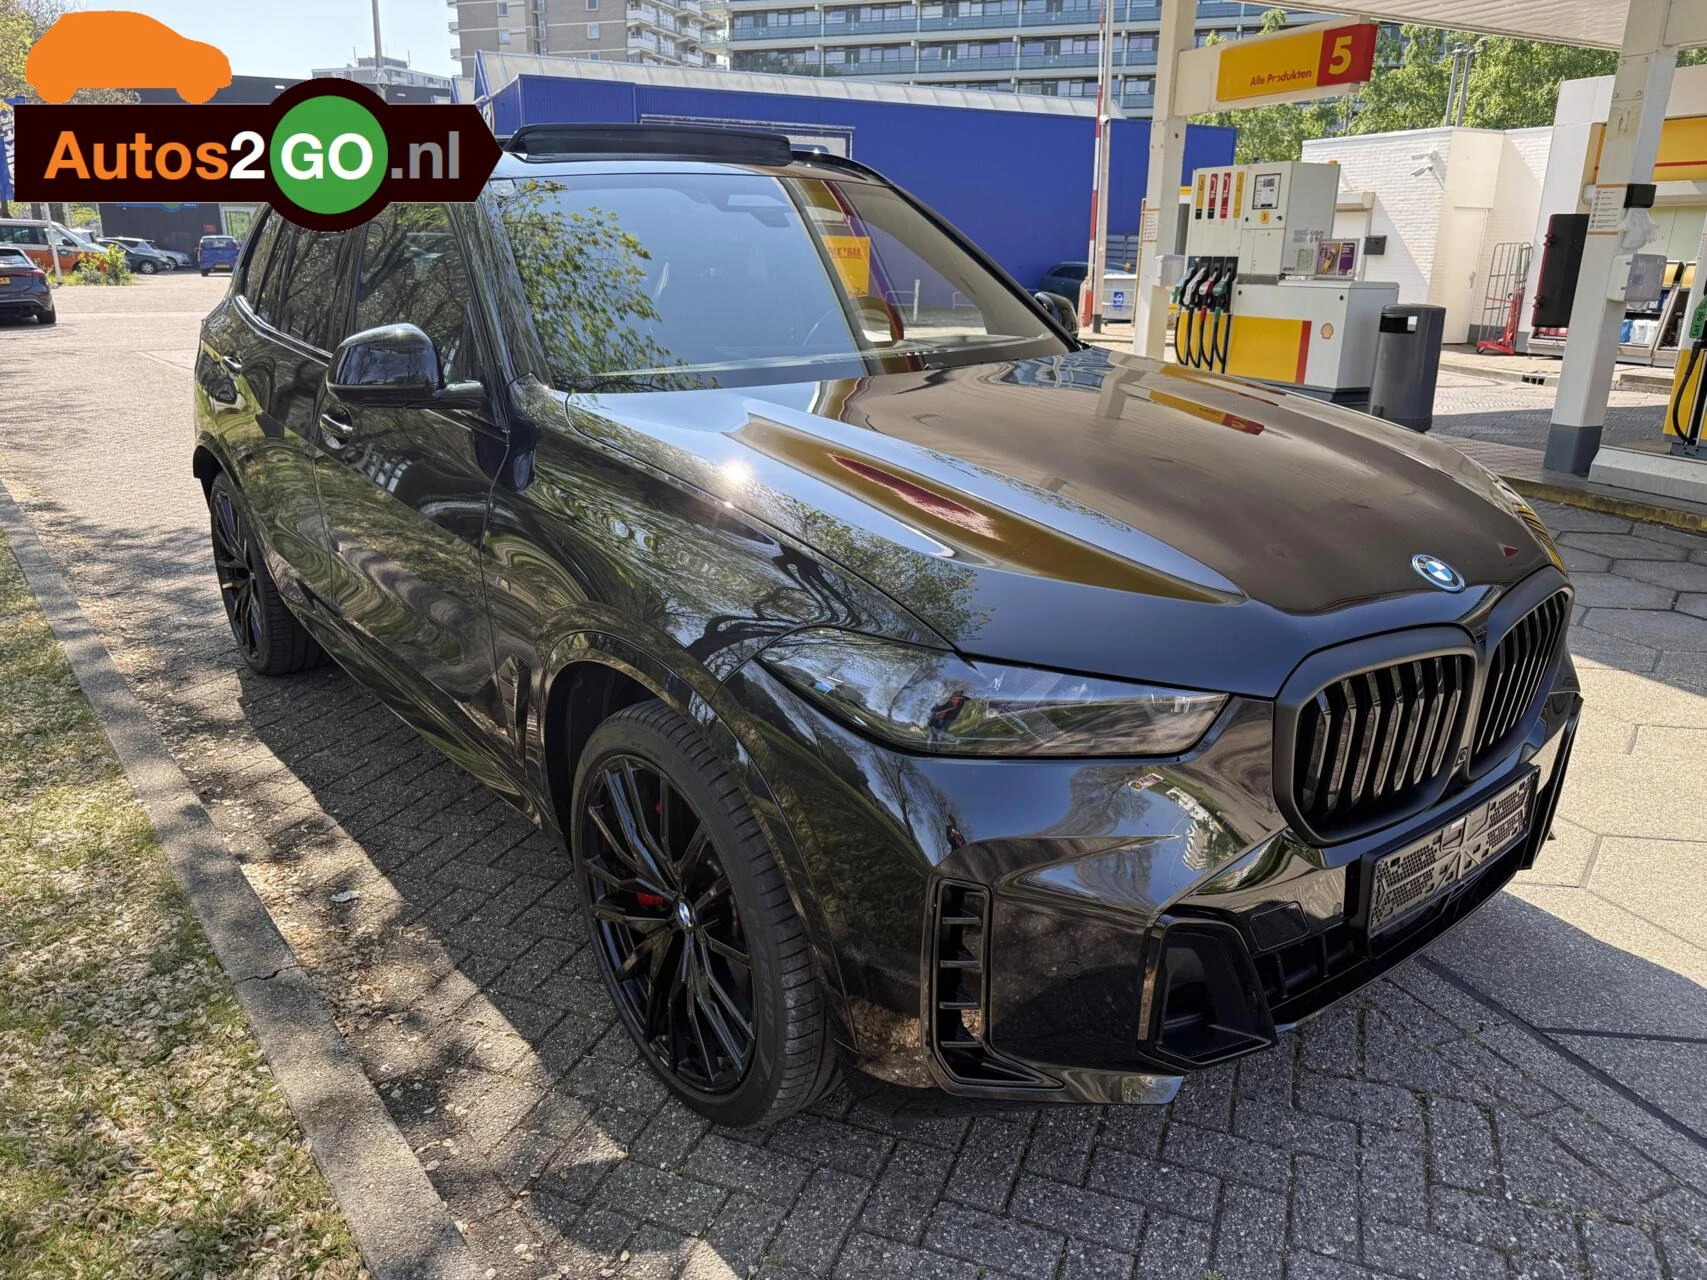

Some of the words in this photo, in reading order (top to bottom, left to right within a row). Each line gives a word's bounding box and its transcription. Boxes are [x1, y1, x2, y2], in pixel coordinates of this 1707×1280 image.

[1328, 35, 1352, 75] 5
[1250, 75, 1265, 86] Alle
[1267, 70, 1312, 84] Produkten
